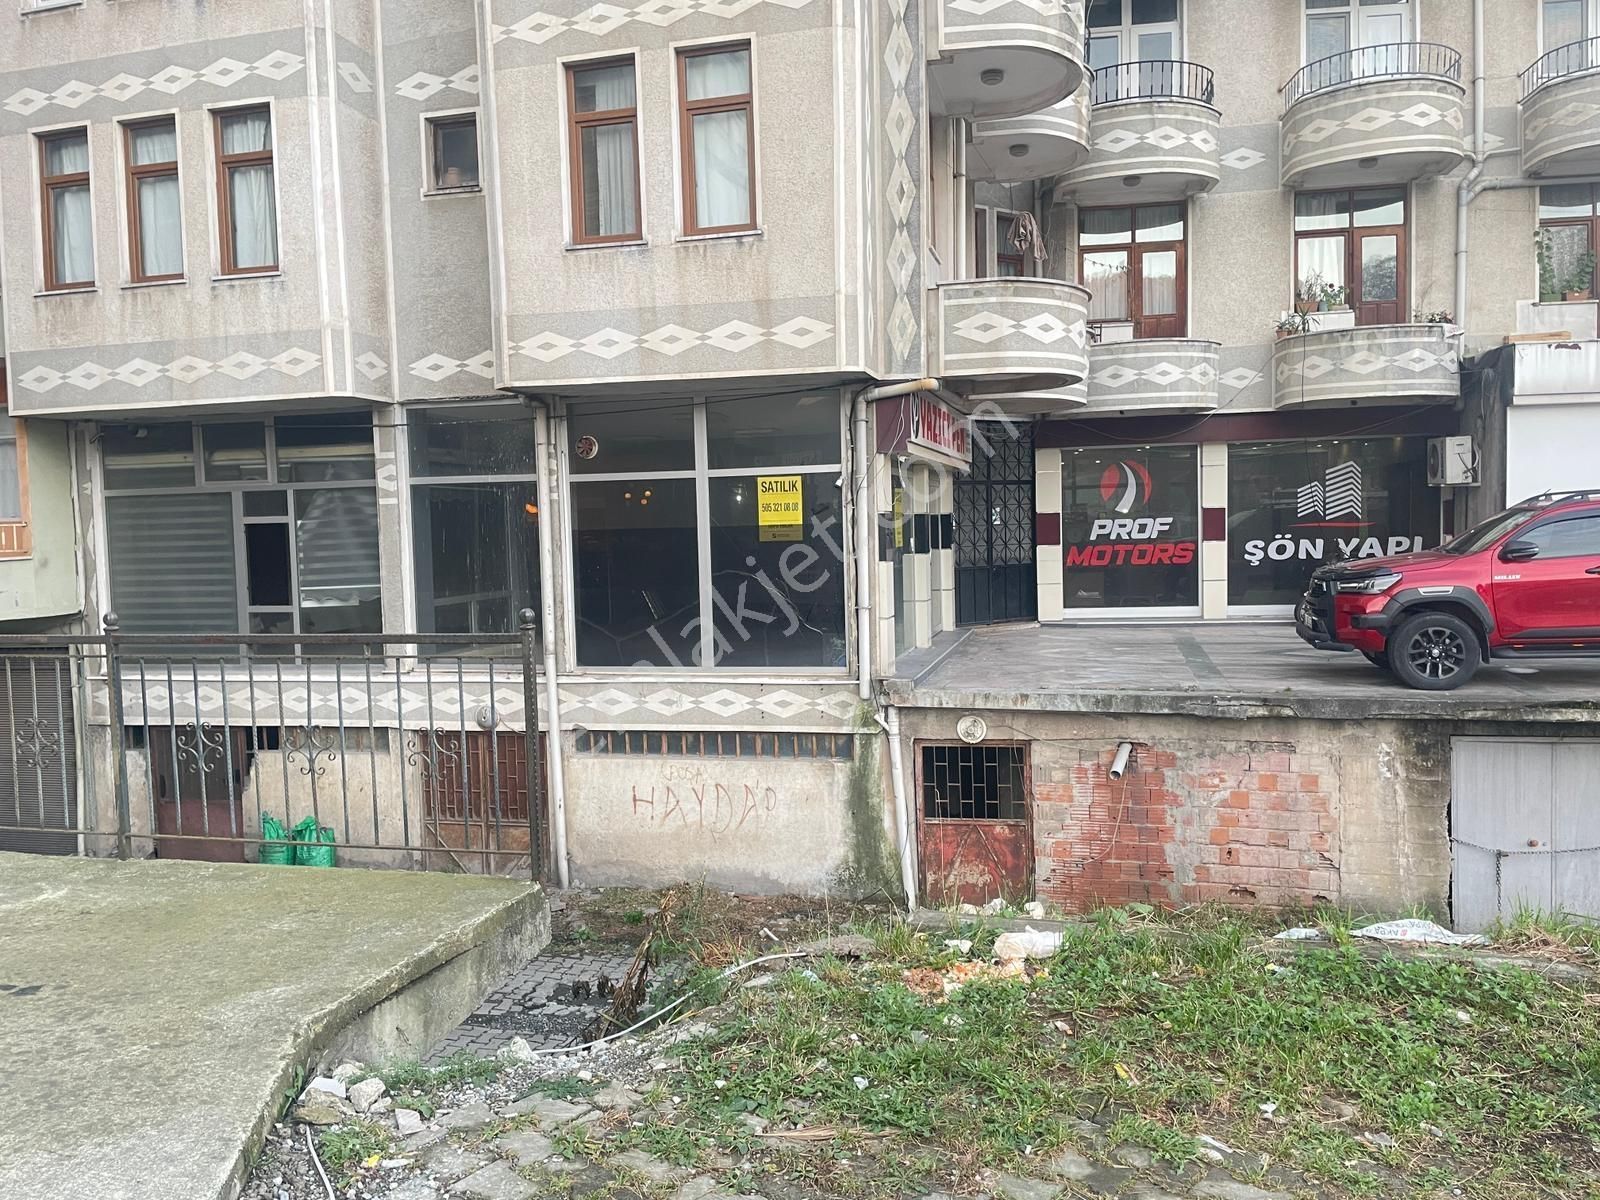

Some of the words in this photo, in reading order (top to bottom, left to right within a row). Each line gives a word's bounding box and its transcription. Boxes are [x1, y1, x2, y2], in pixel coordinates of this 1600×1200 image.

[761, 480, 798, 493] SATILIK
[1089, 517, 1174, 540] PROF
[1066, 543, 1196, 567] MOTORS
[1244, 533, 1324, 566] ŞÖN
[1335, 536, 1423, 559] YAPI
